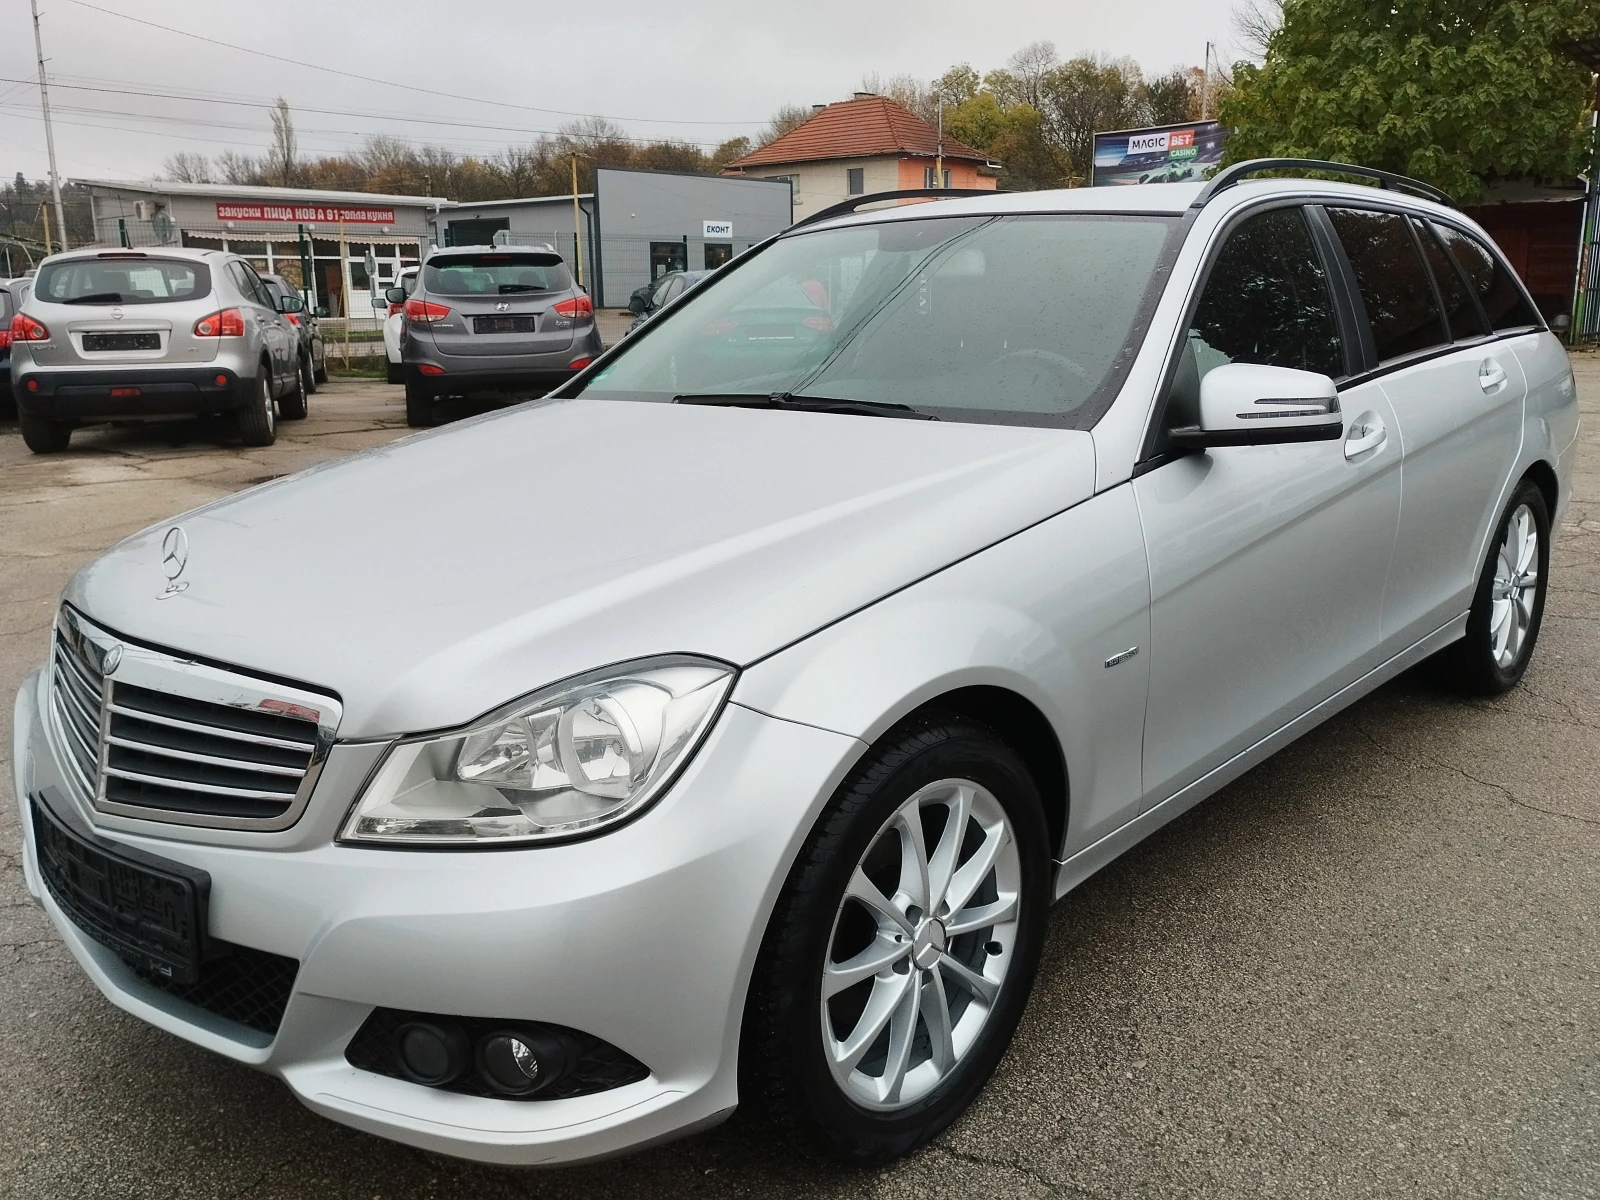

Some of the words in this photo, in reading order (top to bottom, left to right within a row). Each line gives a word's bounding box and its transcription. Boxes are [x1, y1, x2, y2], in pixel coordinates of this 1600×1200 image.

[1132, 137, 1165, 149] MAGIC
[1171, 135, 1191, 146] BET
[1170, 148, 1197, 157] CASINO
[218, 207, 261, 218] закуски
[263, 206, 293, 221] ПИЦА
[367, 211, 393, 221] кухня
[706, 225, 729, 233] ЕКОНТ
